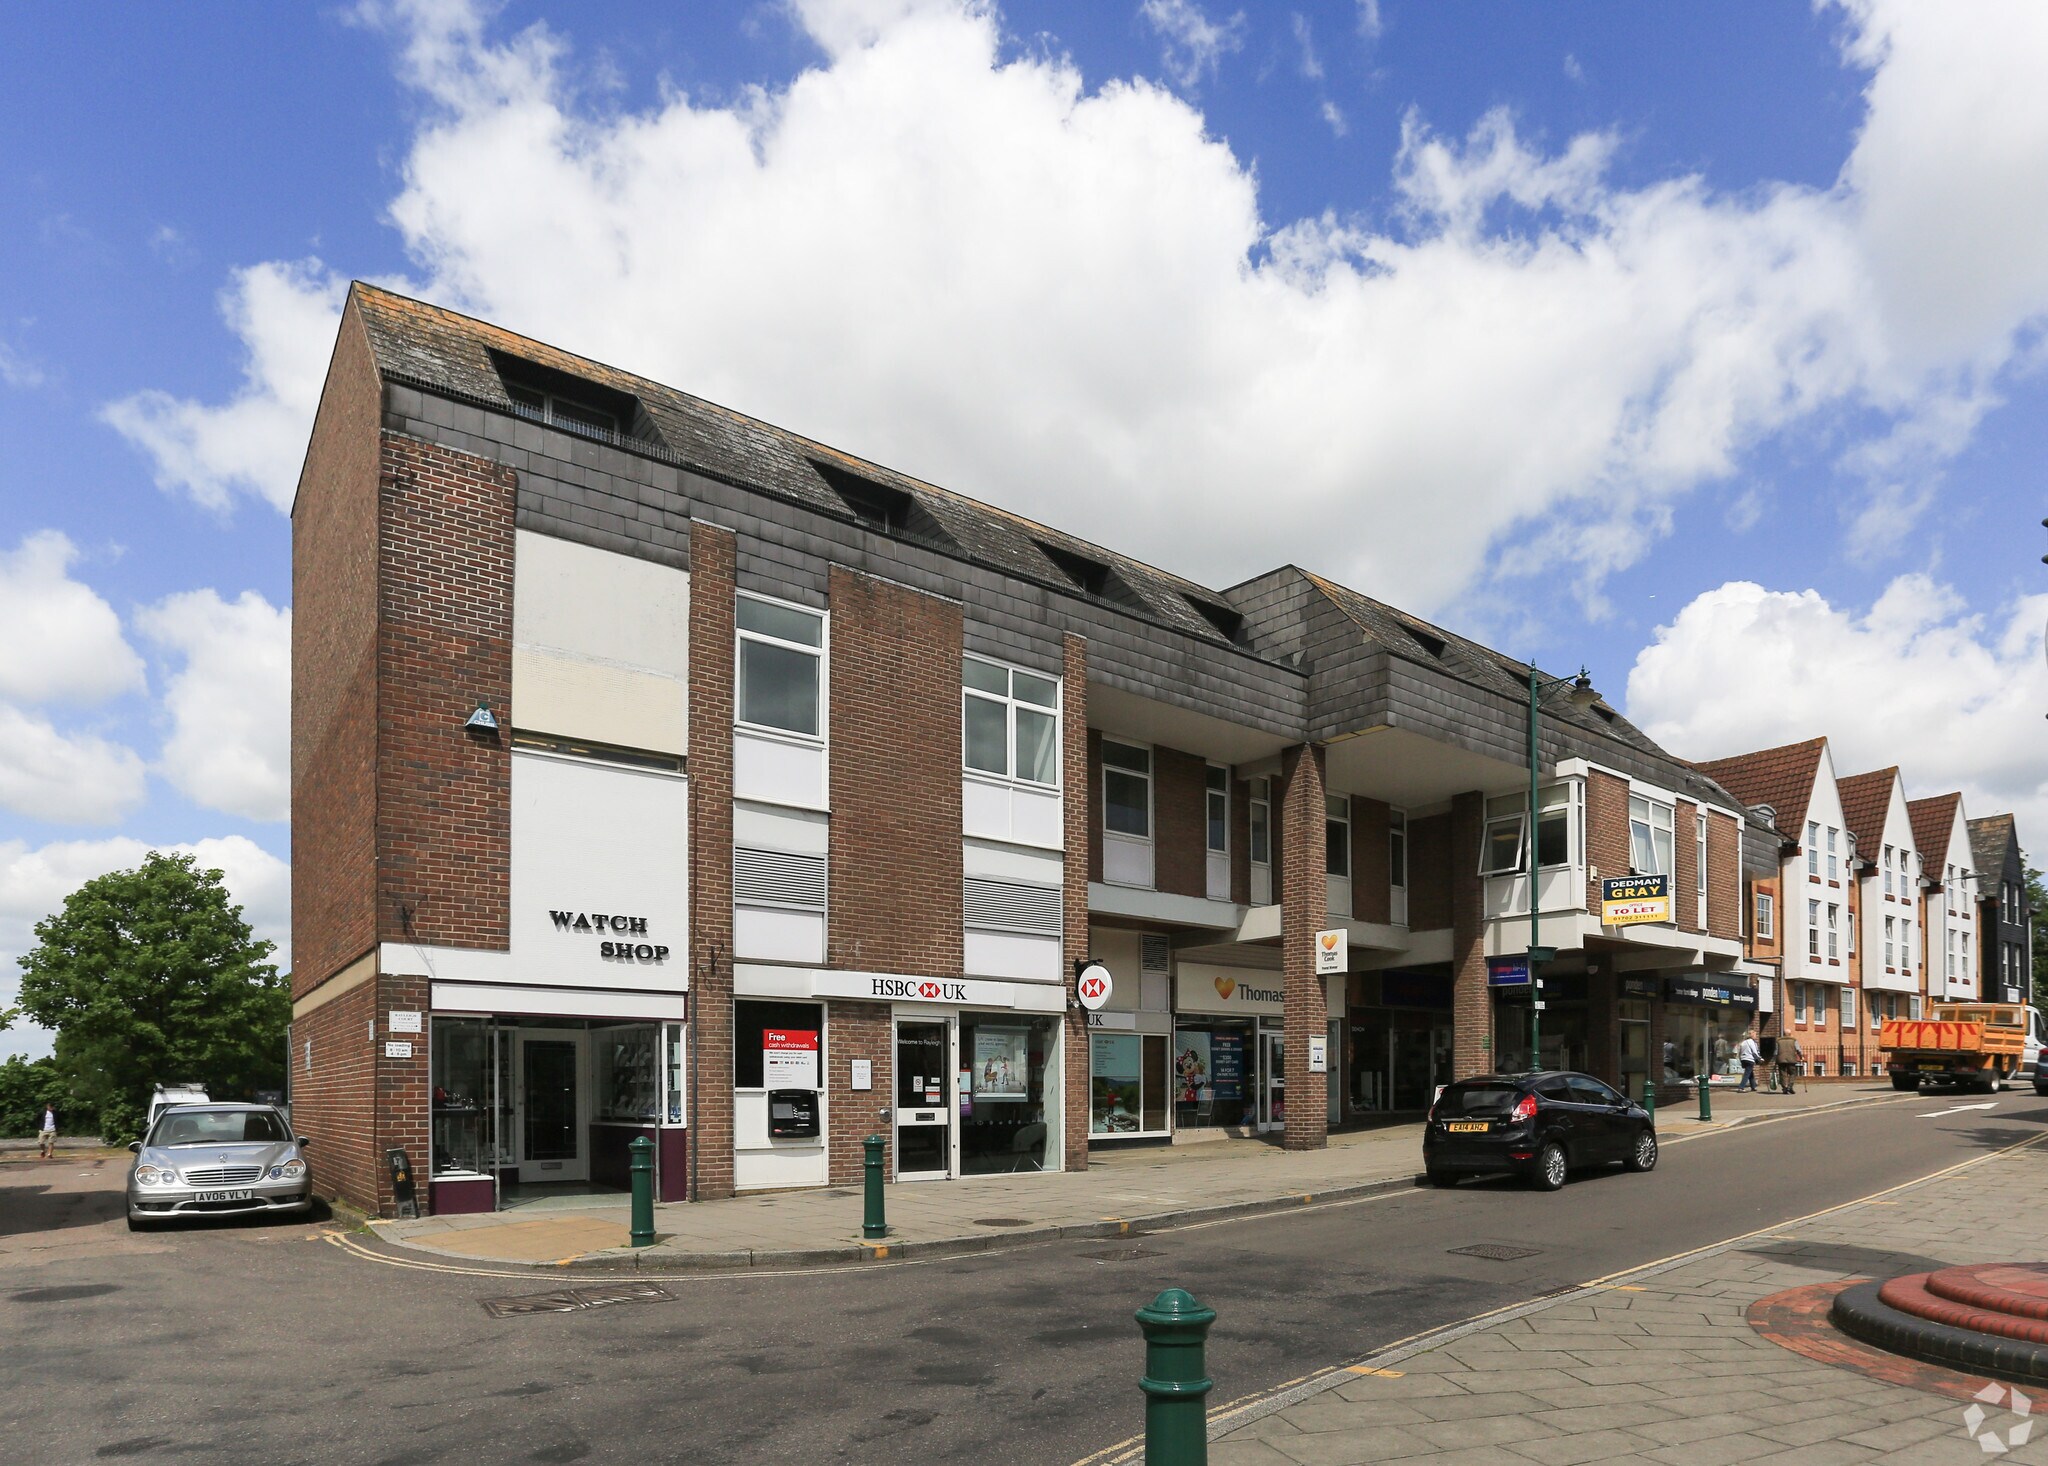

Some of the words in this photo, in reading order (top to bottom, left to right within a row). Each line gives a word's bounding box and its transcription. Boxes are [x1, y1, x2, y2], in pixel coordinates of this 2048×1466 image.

[1610, 878, 1661, 888] DEDMAN
[1611, 886, 1660, 898] GRAY
[549, 910, 648, 933] WATCH
[600, 941, 670, 961] SHOP
[871, 978, 917, 998] HSBC
[942, 983, 968, 1001] UK
[1237, 983, 1285, 1003] Thomas
[1718, 987, 1730, 999] home
[1087, 1013, 1104, 1026] UK
[768, 1032, 786, 1041] Free
[1453, 1123, 1469, 1131] EA14
[1470, 1123, 1484, 1131] AHZ
[199, 1192, 226, 1201] AV06
[229, 1190, 248, 1200] VLY
